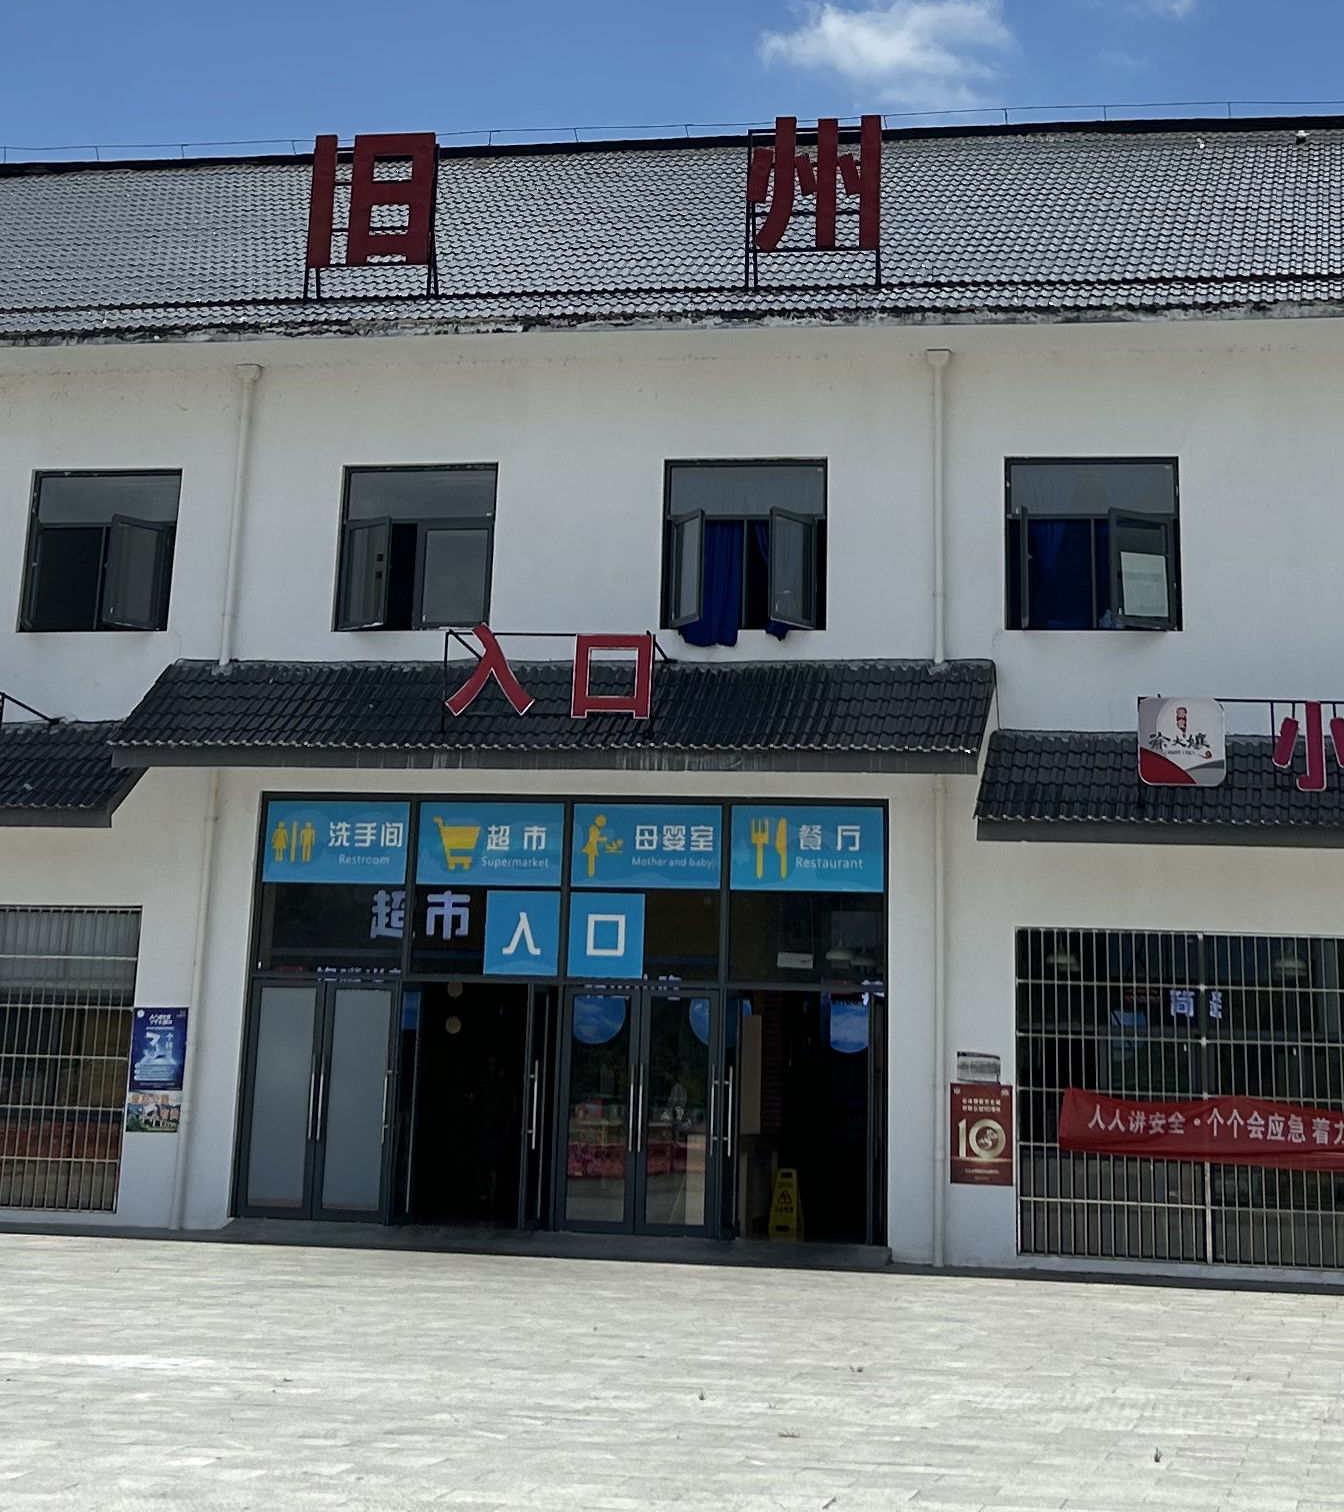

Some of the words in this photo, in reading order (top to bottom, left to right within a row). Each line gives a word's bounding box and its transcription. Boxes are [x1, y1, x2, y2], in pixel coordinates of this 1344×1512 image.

[306, 115, 883, 268] 旧州
[445, 622, 654, 719] 入口
[328, 821, 404, 847] 洗手间
[486, 824, 547, 851] 超市
[635, 824, 714, 851] 母婴室
[799, 824, 860, 851] 餐厅
[338, 854, 390, 865] Restroom
[481, 855, 550, 869] Supermarket
[632, 856, 666, 867] Mother
[669, 856, 687, 867] and
[688, 856, 713, 870] baby
[795, 856, 864, 869] Restaurant
[370, 889, 471, 940] 超市
[502, 912, 626, 956] 入口
[958, 1118, 1007, 1160] 10
